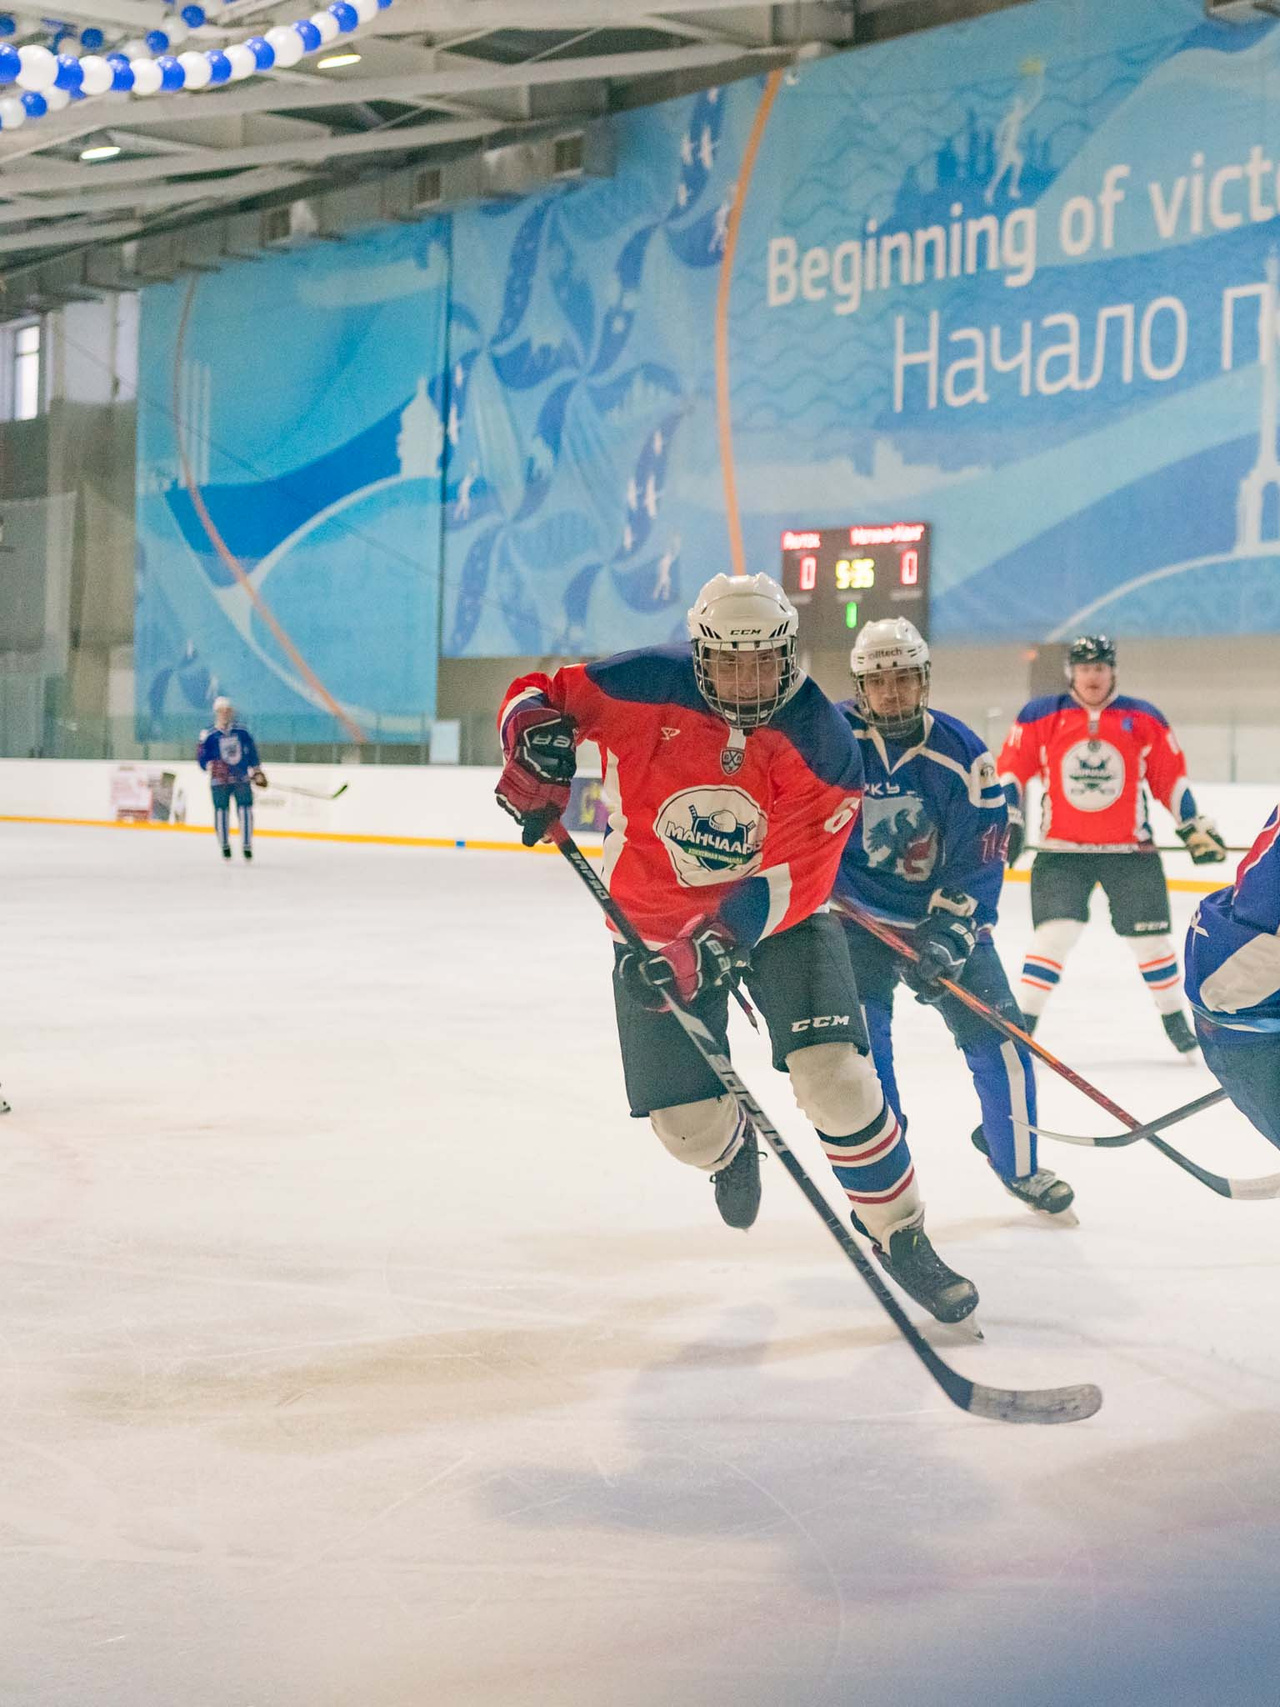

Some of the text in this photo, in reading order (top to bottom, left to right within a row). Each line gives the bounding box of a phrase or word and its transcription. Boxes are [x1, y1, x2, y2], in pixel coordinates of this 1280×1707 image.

[767, 201, 1038, 316] Beginning
[1058, 163, 1132, 257] of
[893, 294, 1188, 413] Начало
[800, 555, 816, 590] 0
[901, 549, 918, 585] 0
[730, 628, 762, 637] CCM
[791, 1014, 851, 1033] CCM
